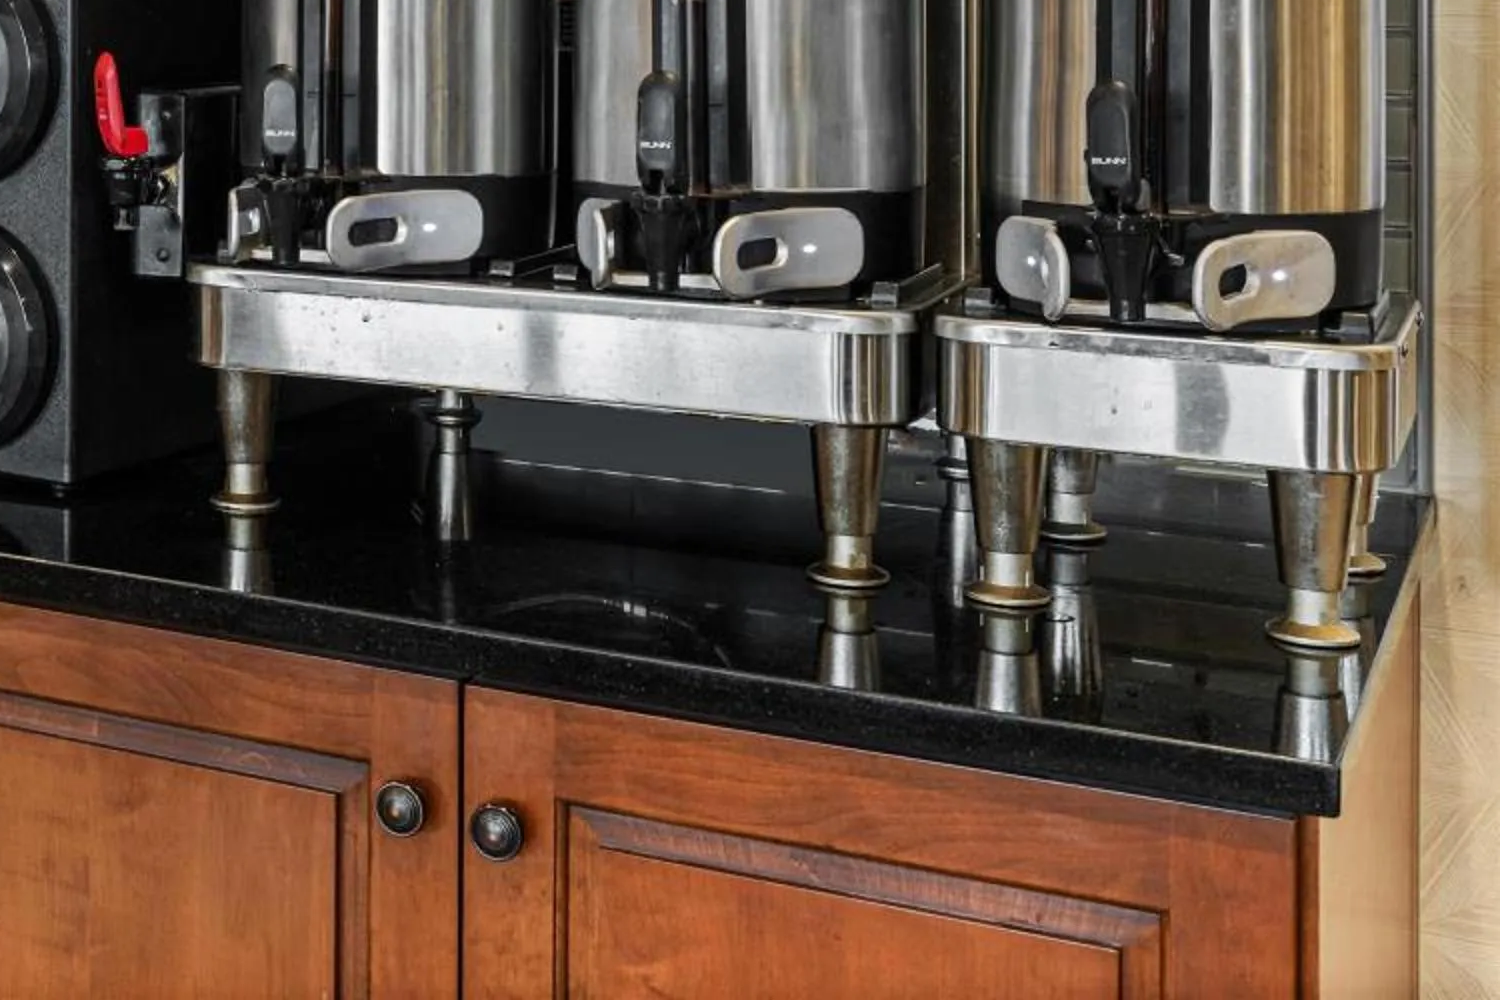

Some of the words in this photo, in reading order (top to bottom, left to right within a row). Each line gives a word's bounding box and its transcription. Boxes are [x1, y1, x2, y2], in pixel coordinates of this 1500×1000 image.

[265, 128, 295, 138] BUNN
[640, 140, 672, 149] BUNN
[1091, 156, 1127, 165] BUNN
